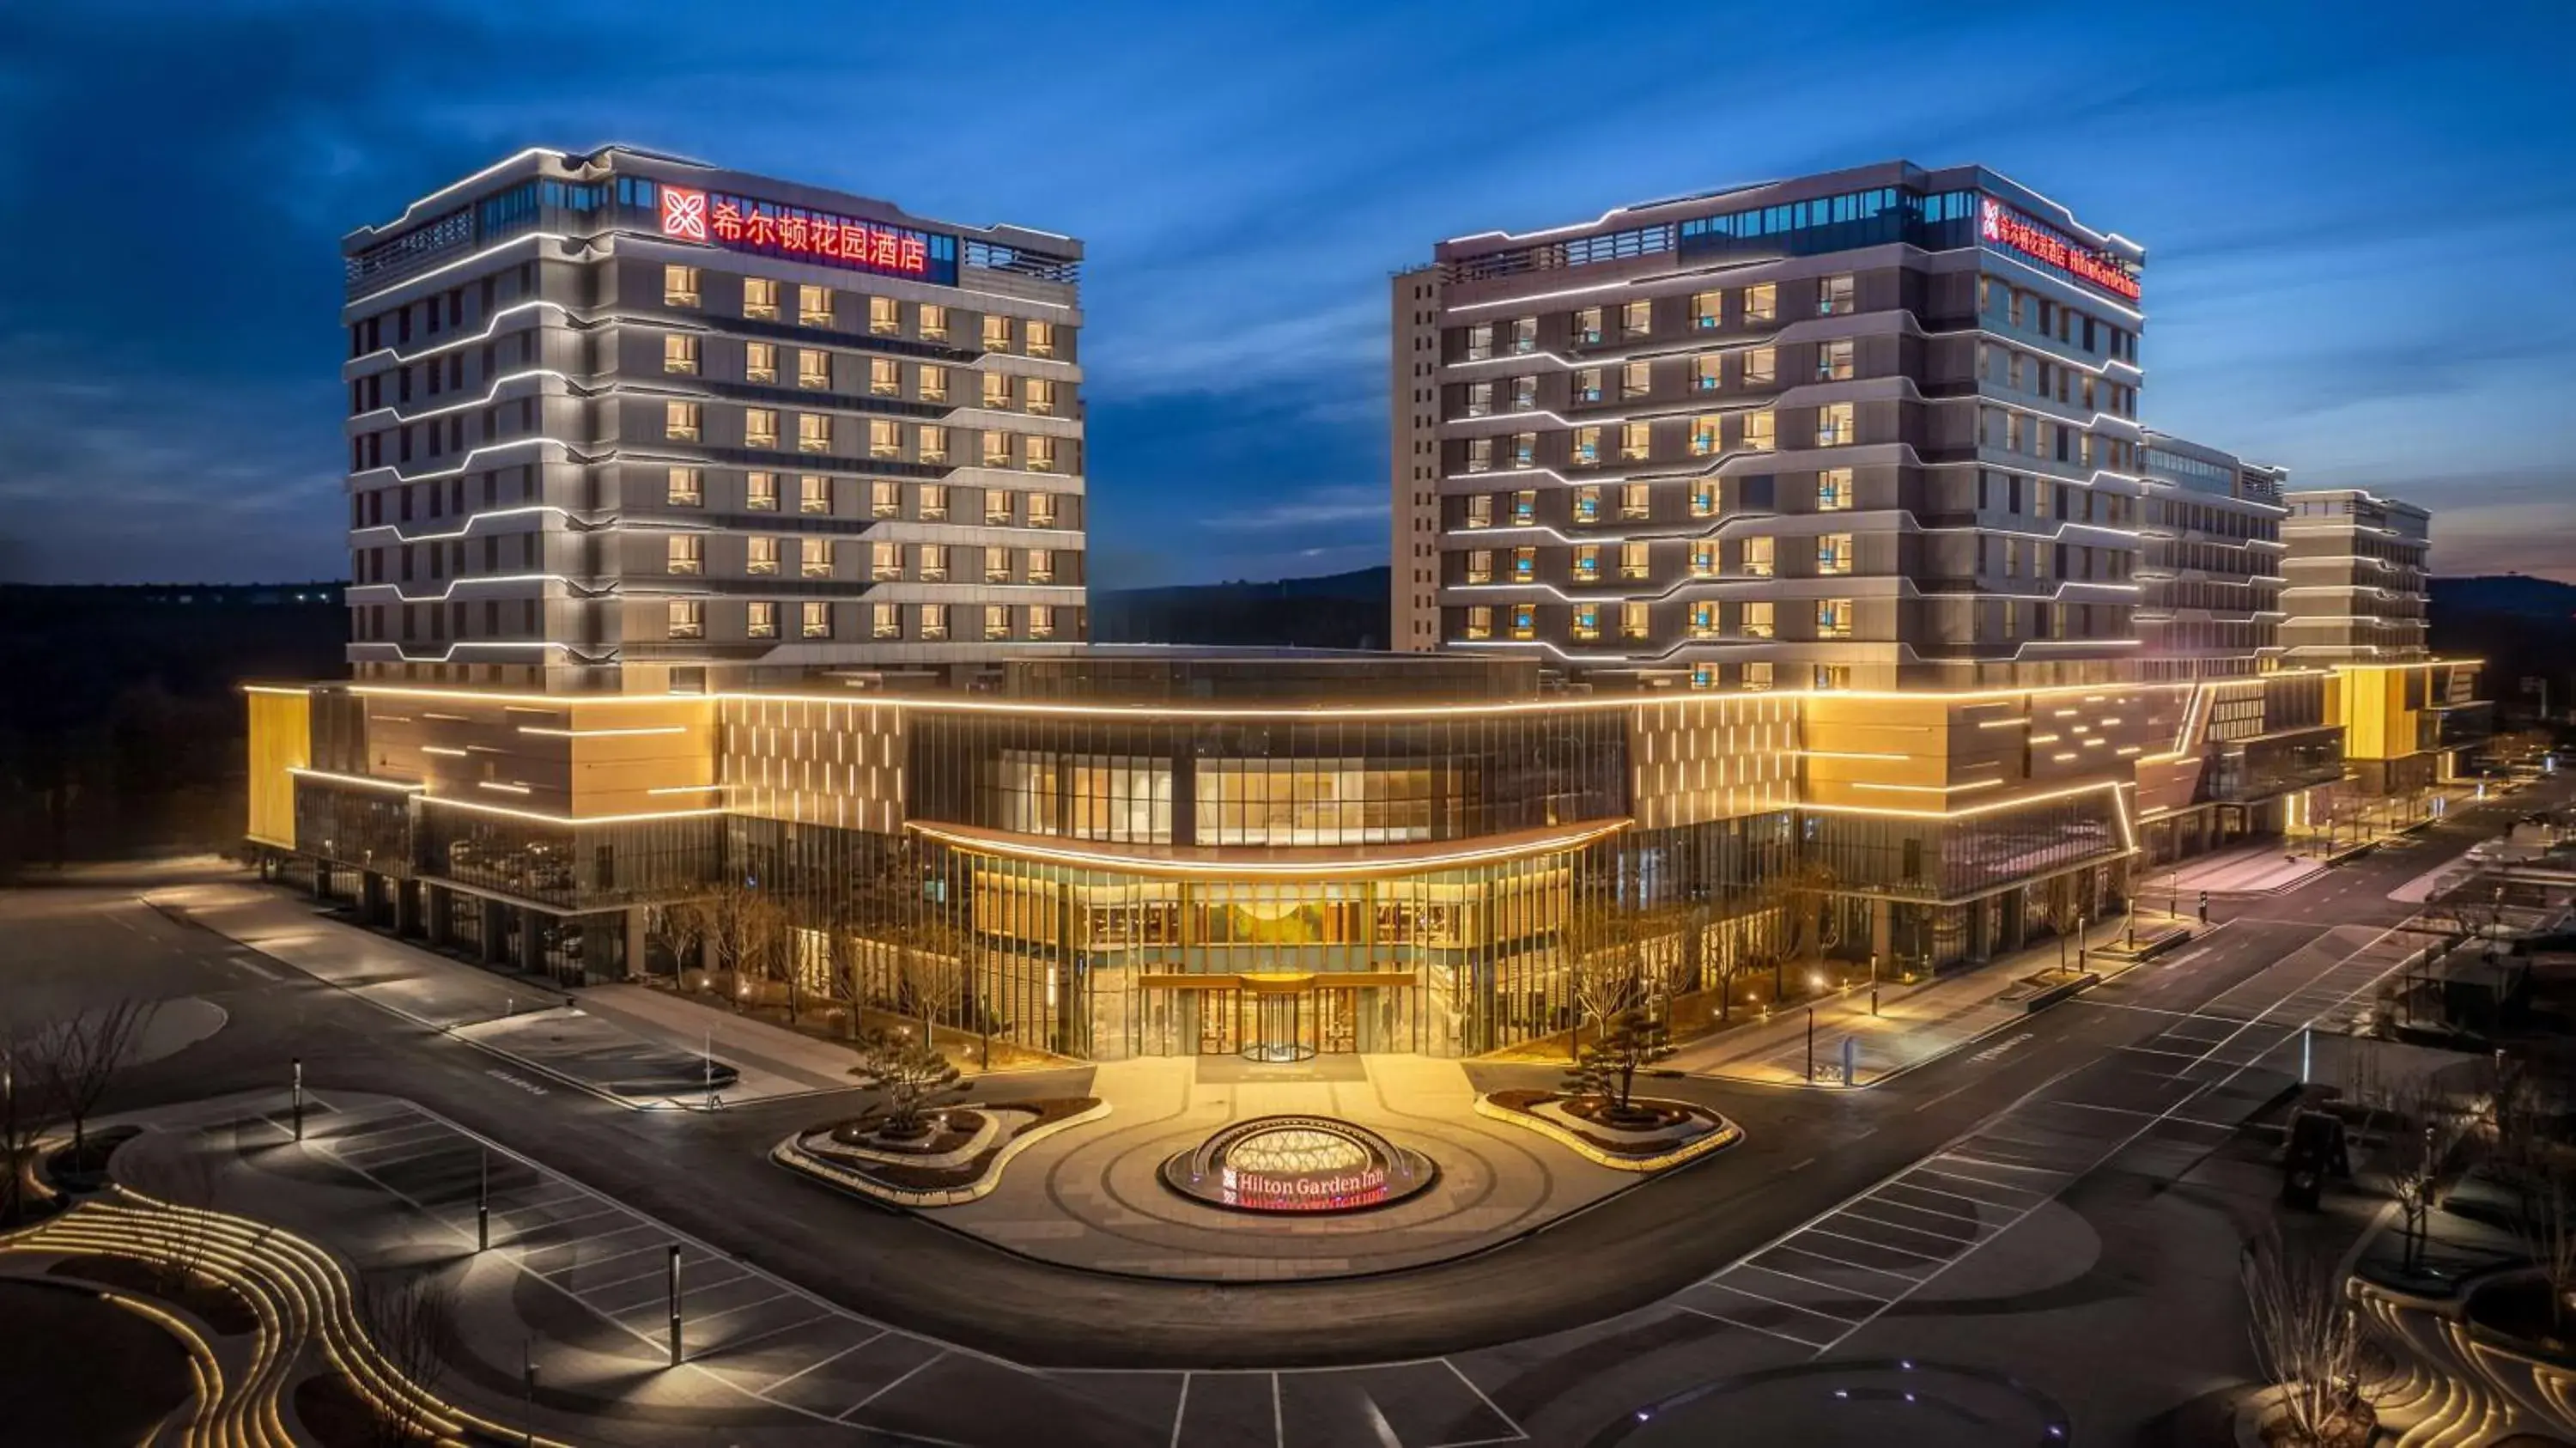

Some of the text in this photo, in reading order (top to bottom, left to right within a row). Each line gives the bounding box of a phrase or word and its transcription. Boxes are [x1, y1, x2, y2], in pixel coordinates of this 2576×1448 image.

[712, 202, 925, 272] 希尔顿花园酒店
[1240, 1167, 1384, 1195] Hilton Garden Inn
